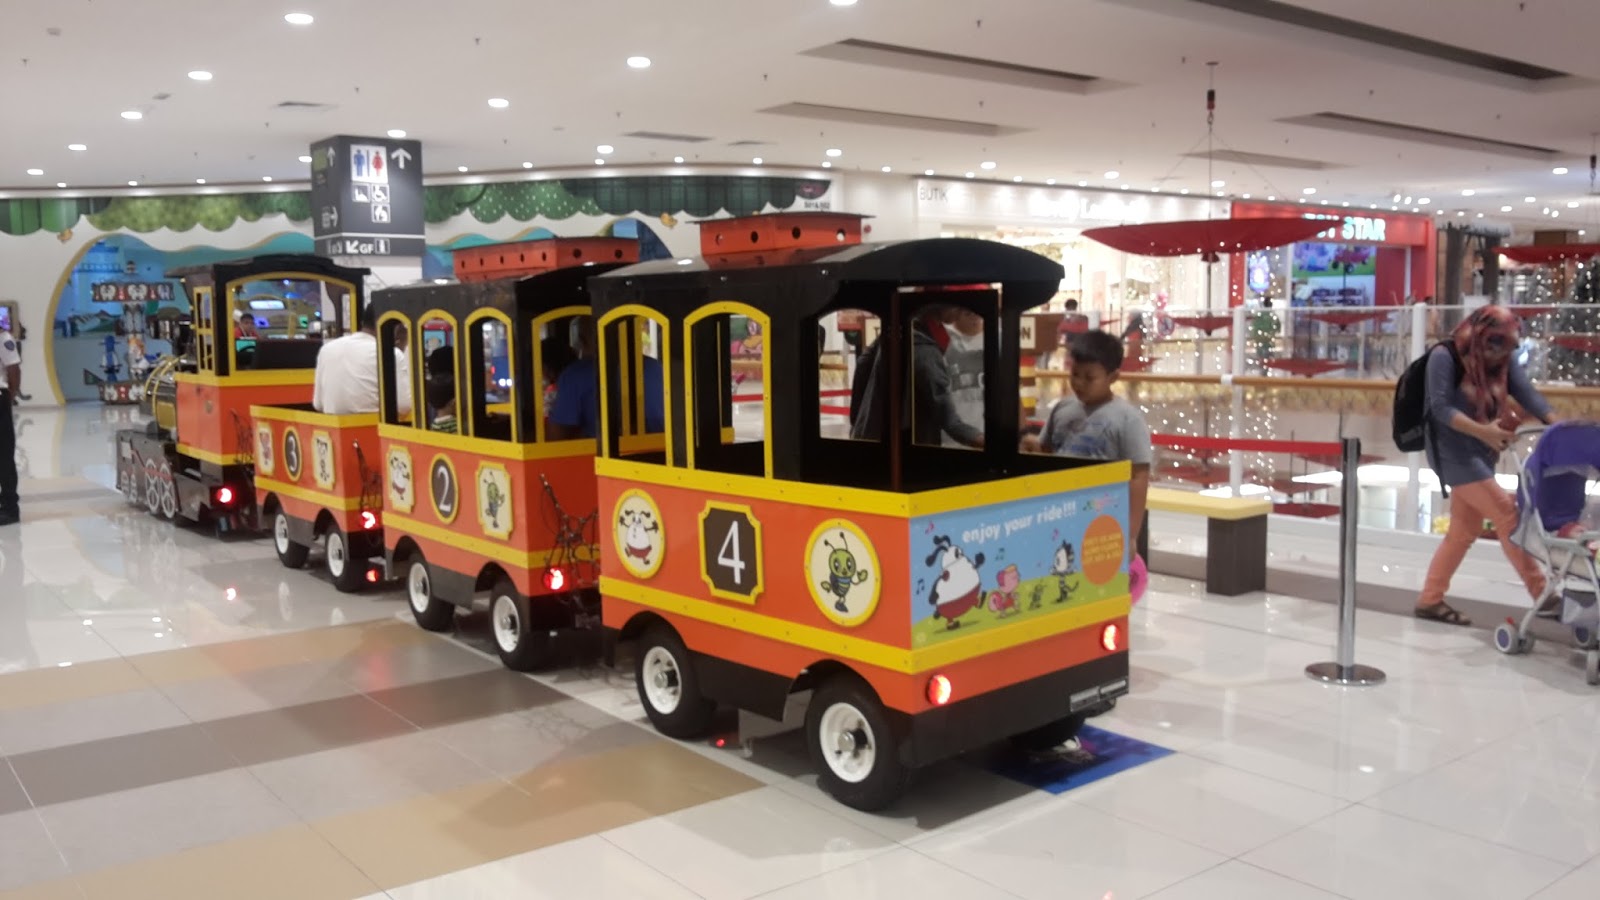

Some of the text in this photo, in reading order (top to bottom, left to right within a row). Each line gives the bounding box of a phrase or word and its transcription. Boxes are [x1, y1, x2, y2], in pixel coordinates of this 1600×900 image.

[1342, 216, 1386, 241] STAR
[360, 243, 374, 254] GF
[287, 435, 298, 472] 3
[437, 465, 451, 511] 2
[962, 523, 1000, 544] enjoy
[1004, 514, 1033, 538] your
[717, 520, 746, 585] 4
